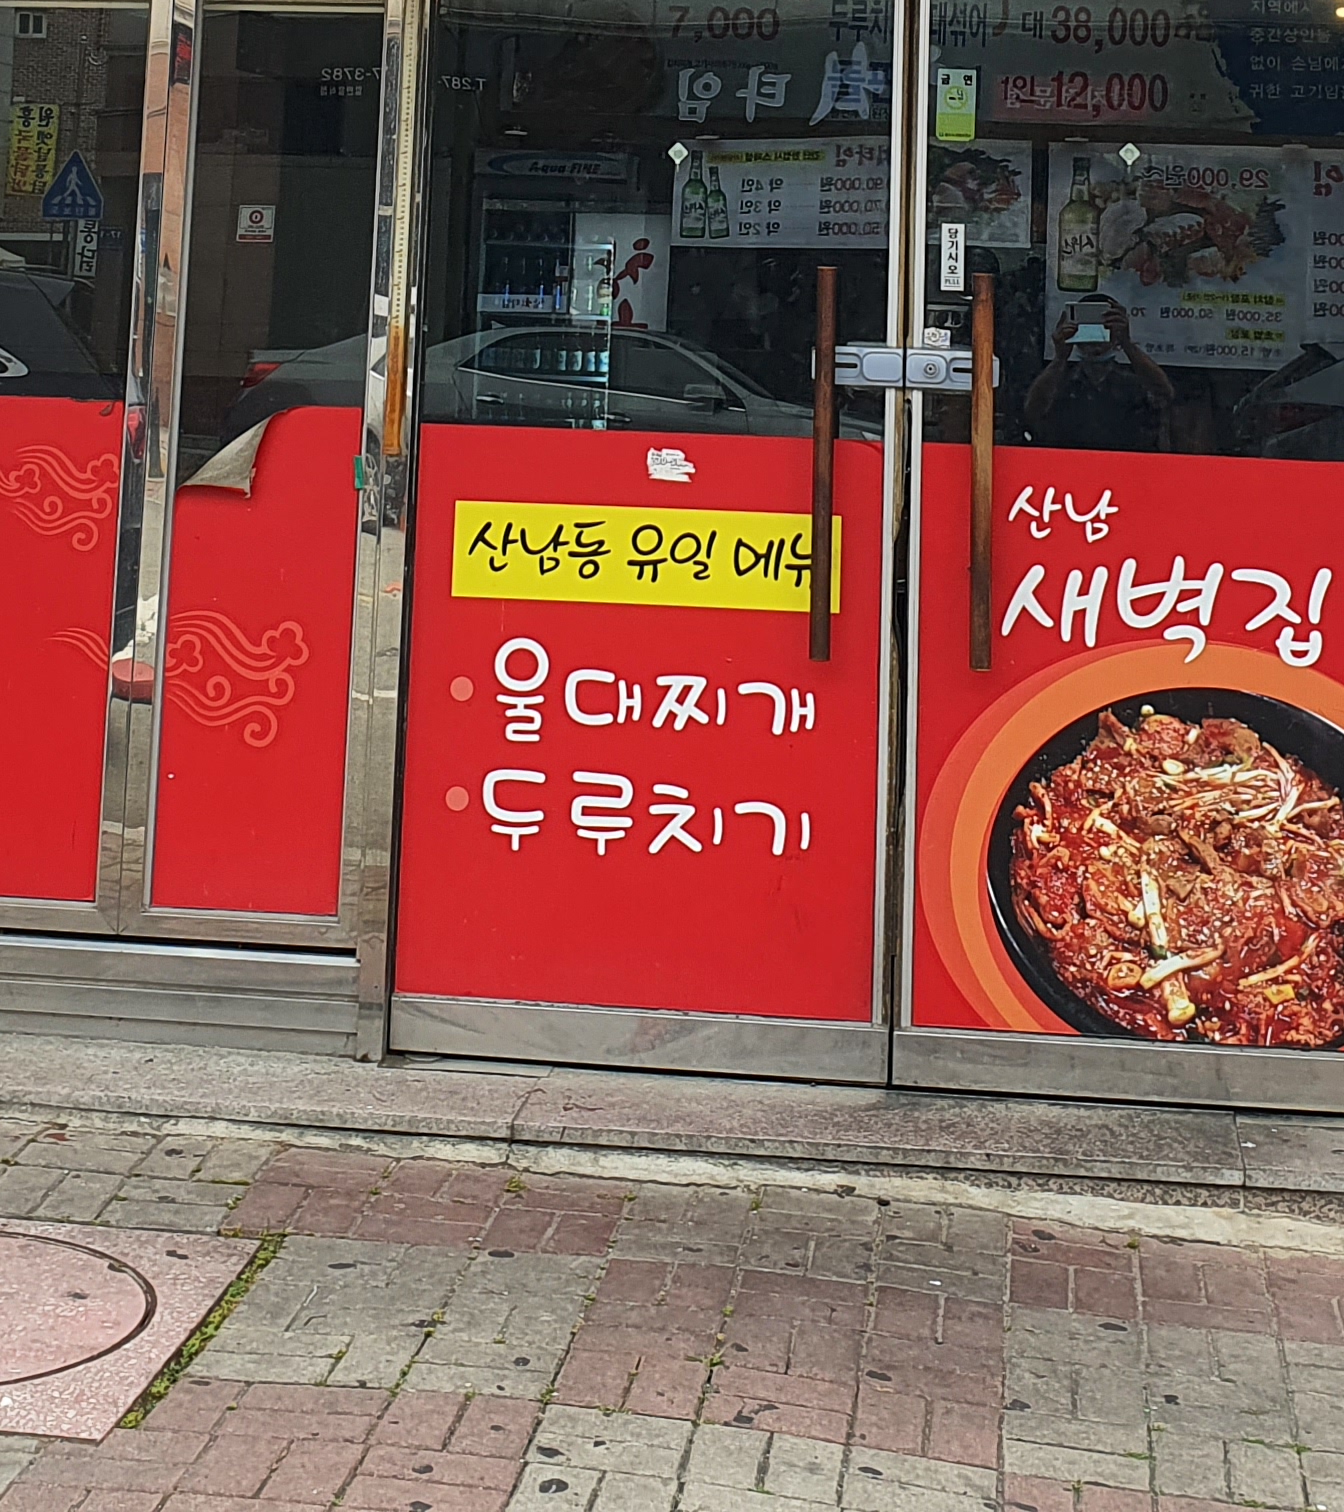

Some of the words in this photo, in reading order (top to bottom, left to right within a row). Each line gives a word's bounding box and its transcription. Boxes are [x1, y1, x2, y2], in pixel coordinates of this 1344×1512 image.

[668, 5, 782, 45] 7,000
[1050, 5, 1171, 55] 38,000
[1050, 70, 1169, 118] 12,000
[946, 226, 959, 275] 당기시오
[1007, 485, 1120, 542] 산남
[468, 519, 613, 581] 산남동
[626, 529, 714, 584] 유일
[1000, 554, 1334, 668] 새벽집
[492, 636, 817, 745] 울대찌개
[481, 766, 812, 857] 두루치기
